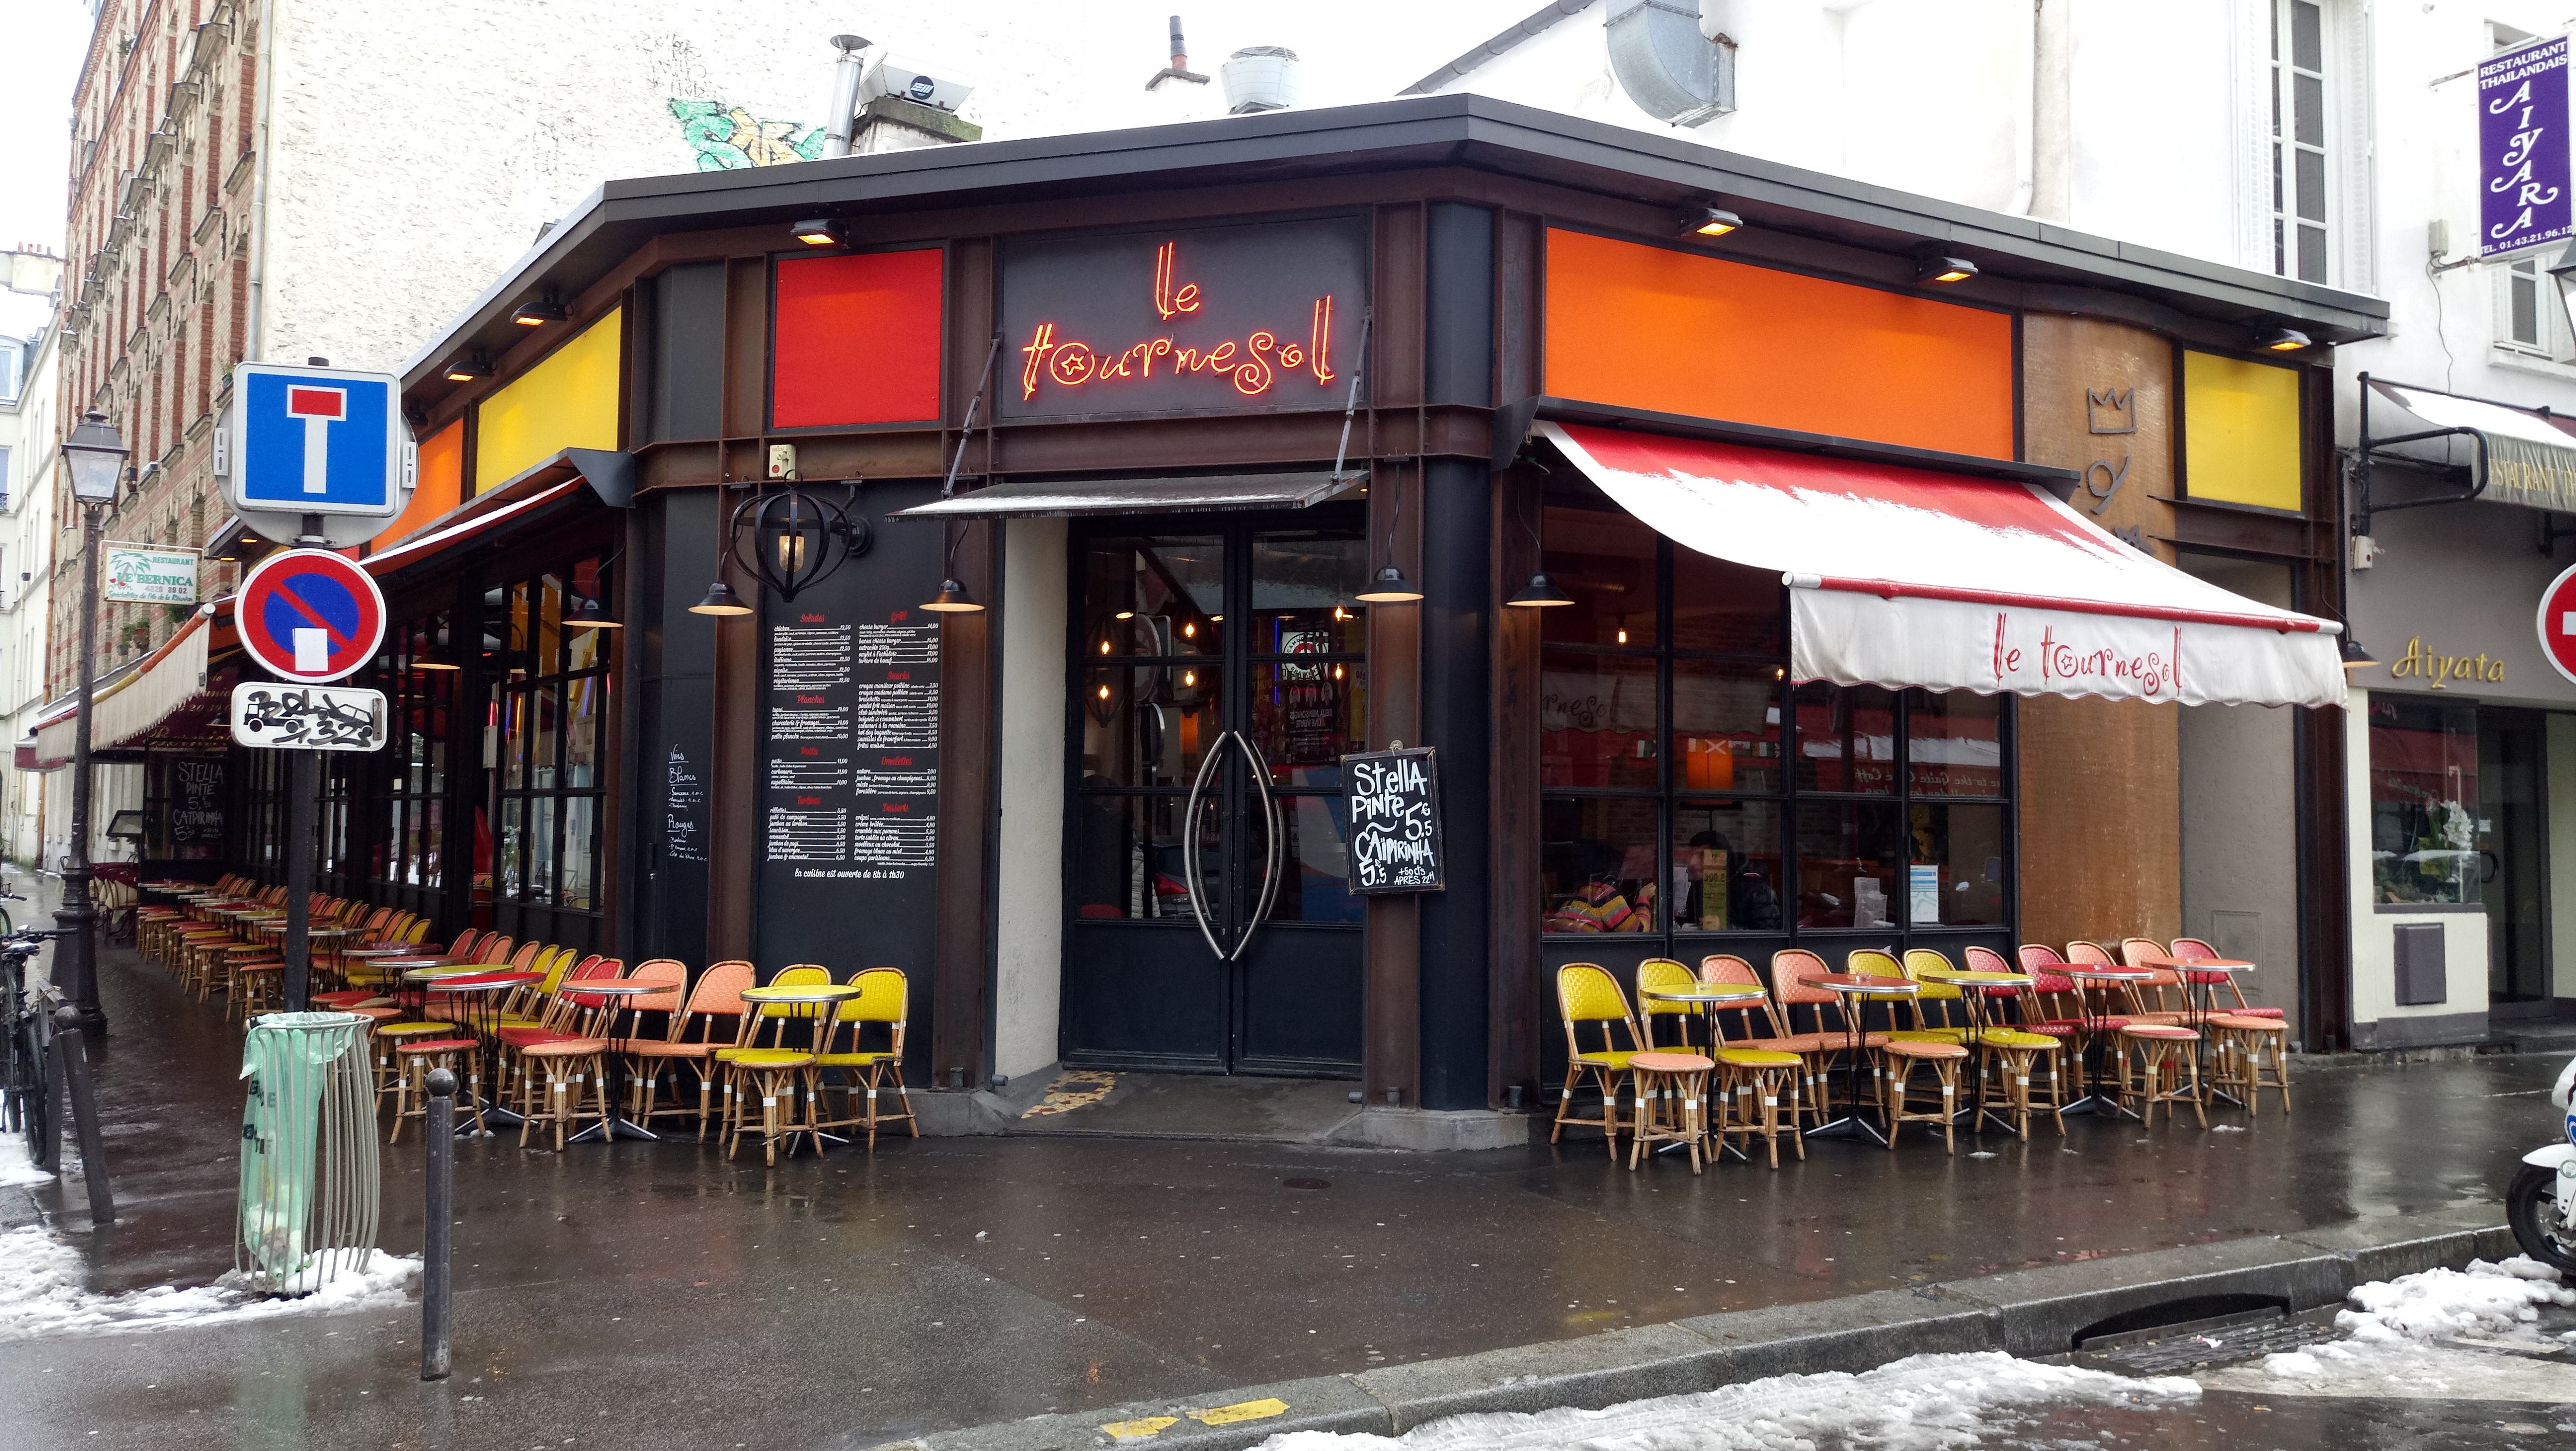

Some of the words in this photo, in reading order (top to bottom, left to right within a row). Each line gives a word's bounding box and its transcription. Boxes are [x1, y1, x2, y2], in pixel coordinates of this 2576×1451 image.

[2480, 41, 2566, 77] RESTAURANT
[2479, 54, 2567, 91] THAILANDAIS
[2489, 80, 2558, 239] AIYARA
[2481, 242, 2496, 255] TEL.
[2499, 225, 2572, 250] 01.43.21.96.12
[1154, 242, 1200, 321] le
[152, 557, 193, 565] RESTAURANT
[117, 572, 133, 582] LE
[137, 574, 193, 586] BERNICA
[1993, 612, 2021, 687] le
[797, 694, 825, 703] Planches
[670, 744, 684, 761] Vins
[881, 756, 913, 765] Omelettes
[178, 761, 223, 784] STELLA
[669, 766, 696, 784] Blancs
[667, 814, 694, 838] Rouges
[795, 868, 802, 877] la
[804, 869, 825, 877] cuisine
[837, 870, 862, 878] ouverte
[863, 870, 871, 878] de
[873, 870, 881, 878] 8h
[889, 871, 904, 879] 1h30
[1394, 876, 1420, 885] APRES
